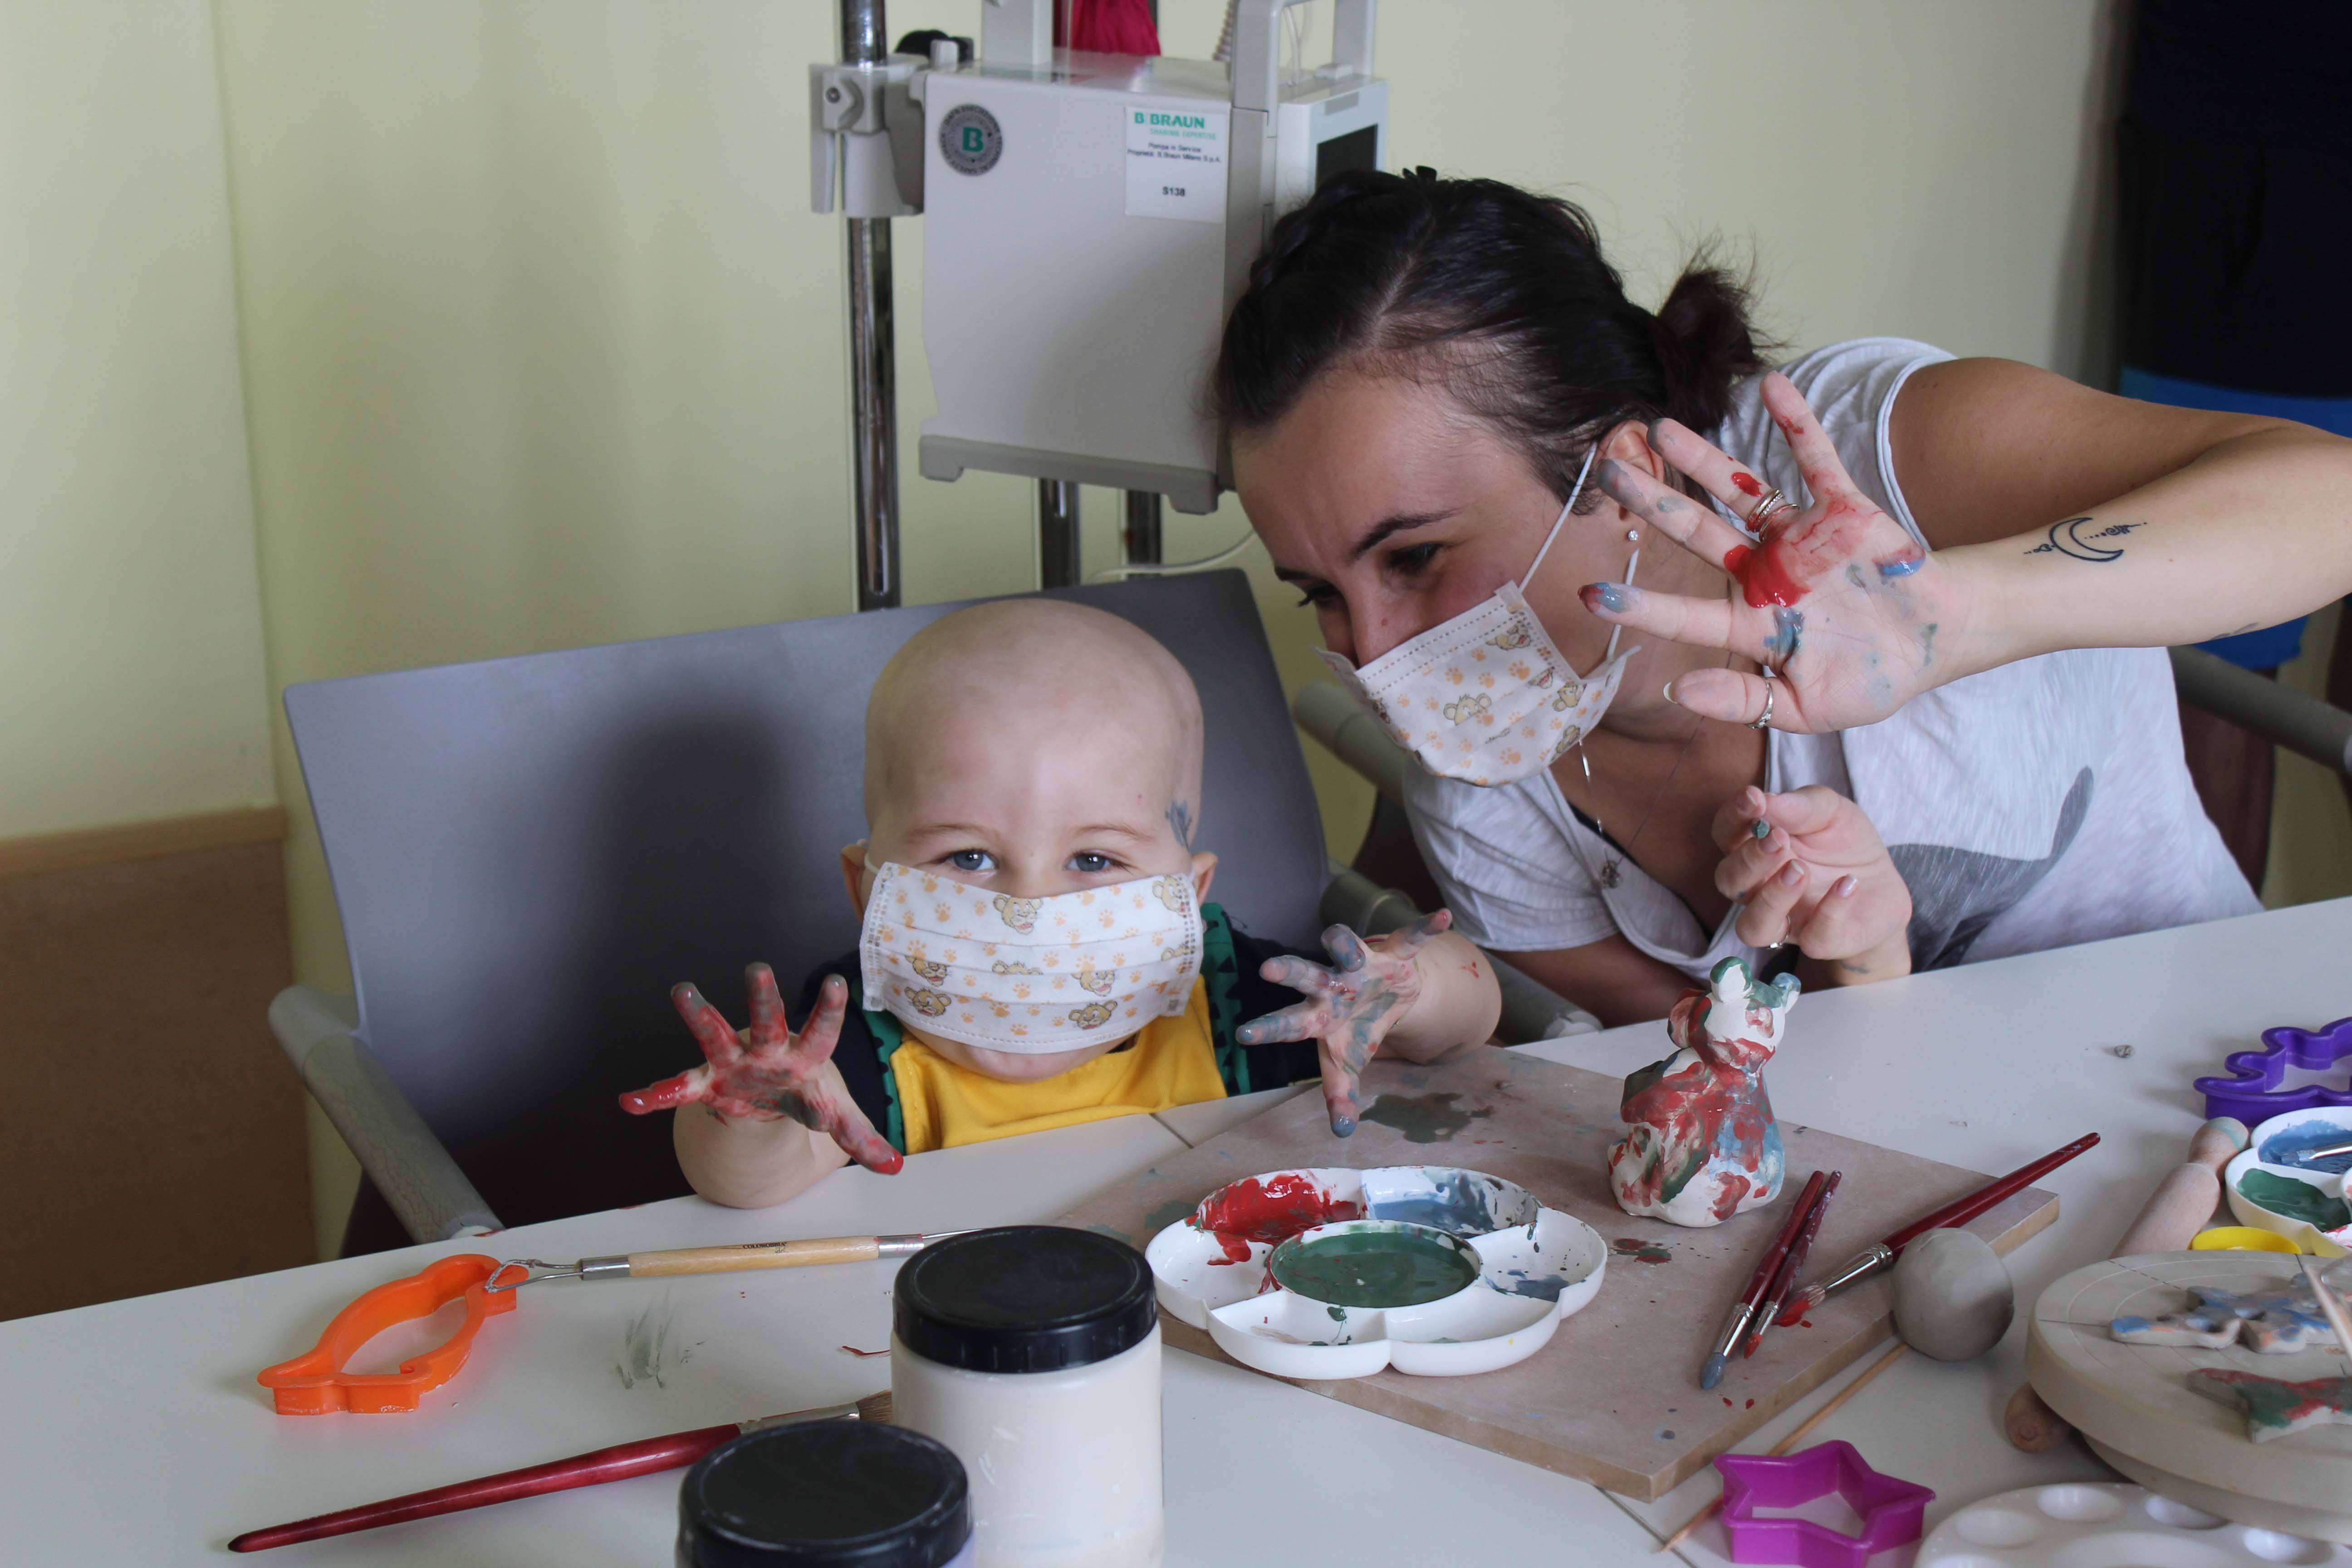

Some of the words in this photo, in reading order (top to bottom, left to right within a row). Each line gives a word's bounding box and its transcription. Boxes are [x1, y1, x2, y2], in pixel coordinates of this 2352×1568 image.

[1134, 112, 1144, 124] B
[1150, 113, 1205, 128] BRAUN
[962, 127, 984, 152] B
[1150, 128, 1180, 137] SHARING
[1182, 130, 1216, 140] EXPERTISE
[1162, 186, 1186, 197] S138
